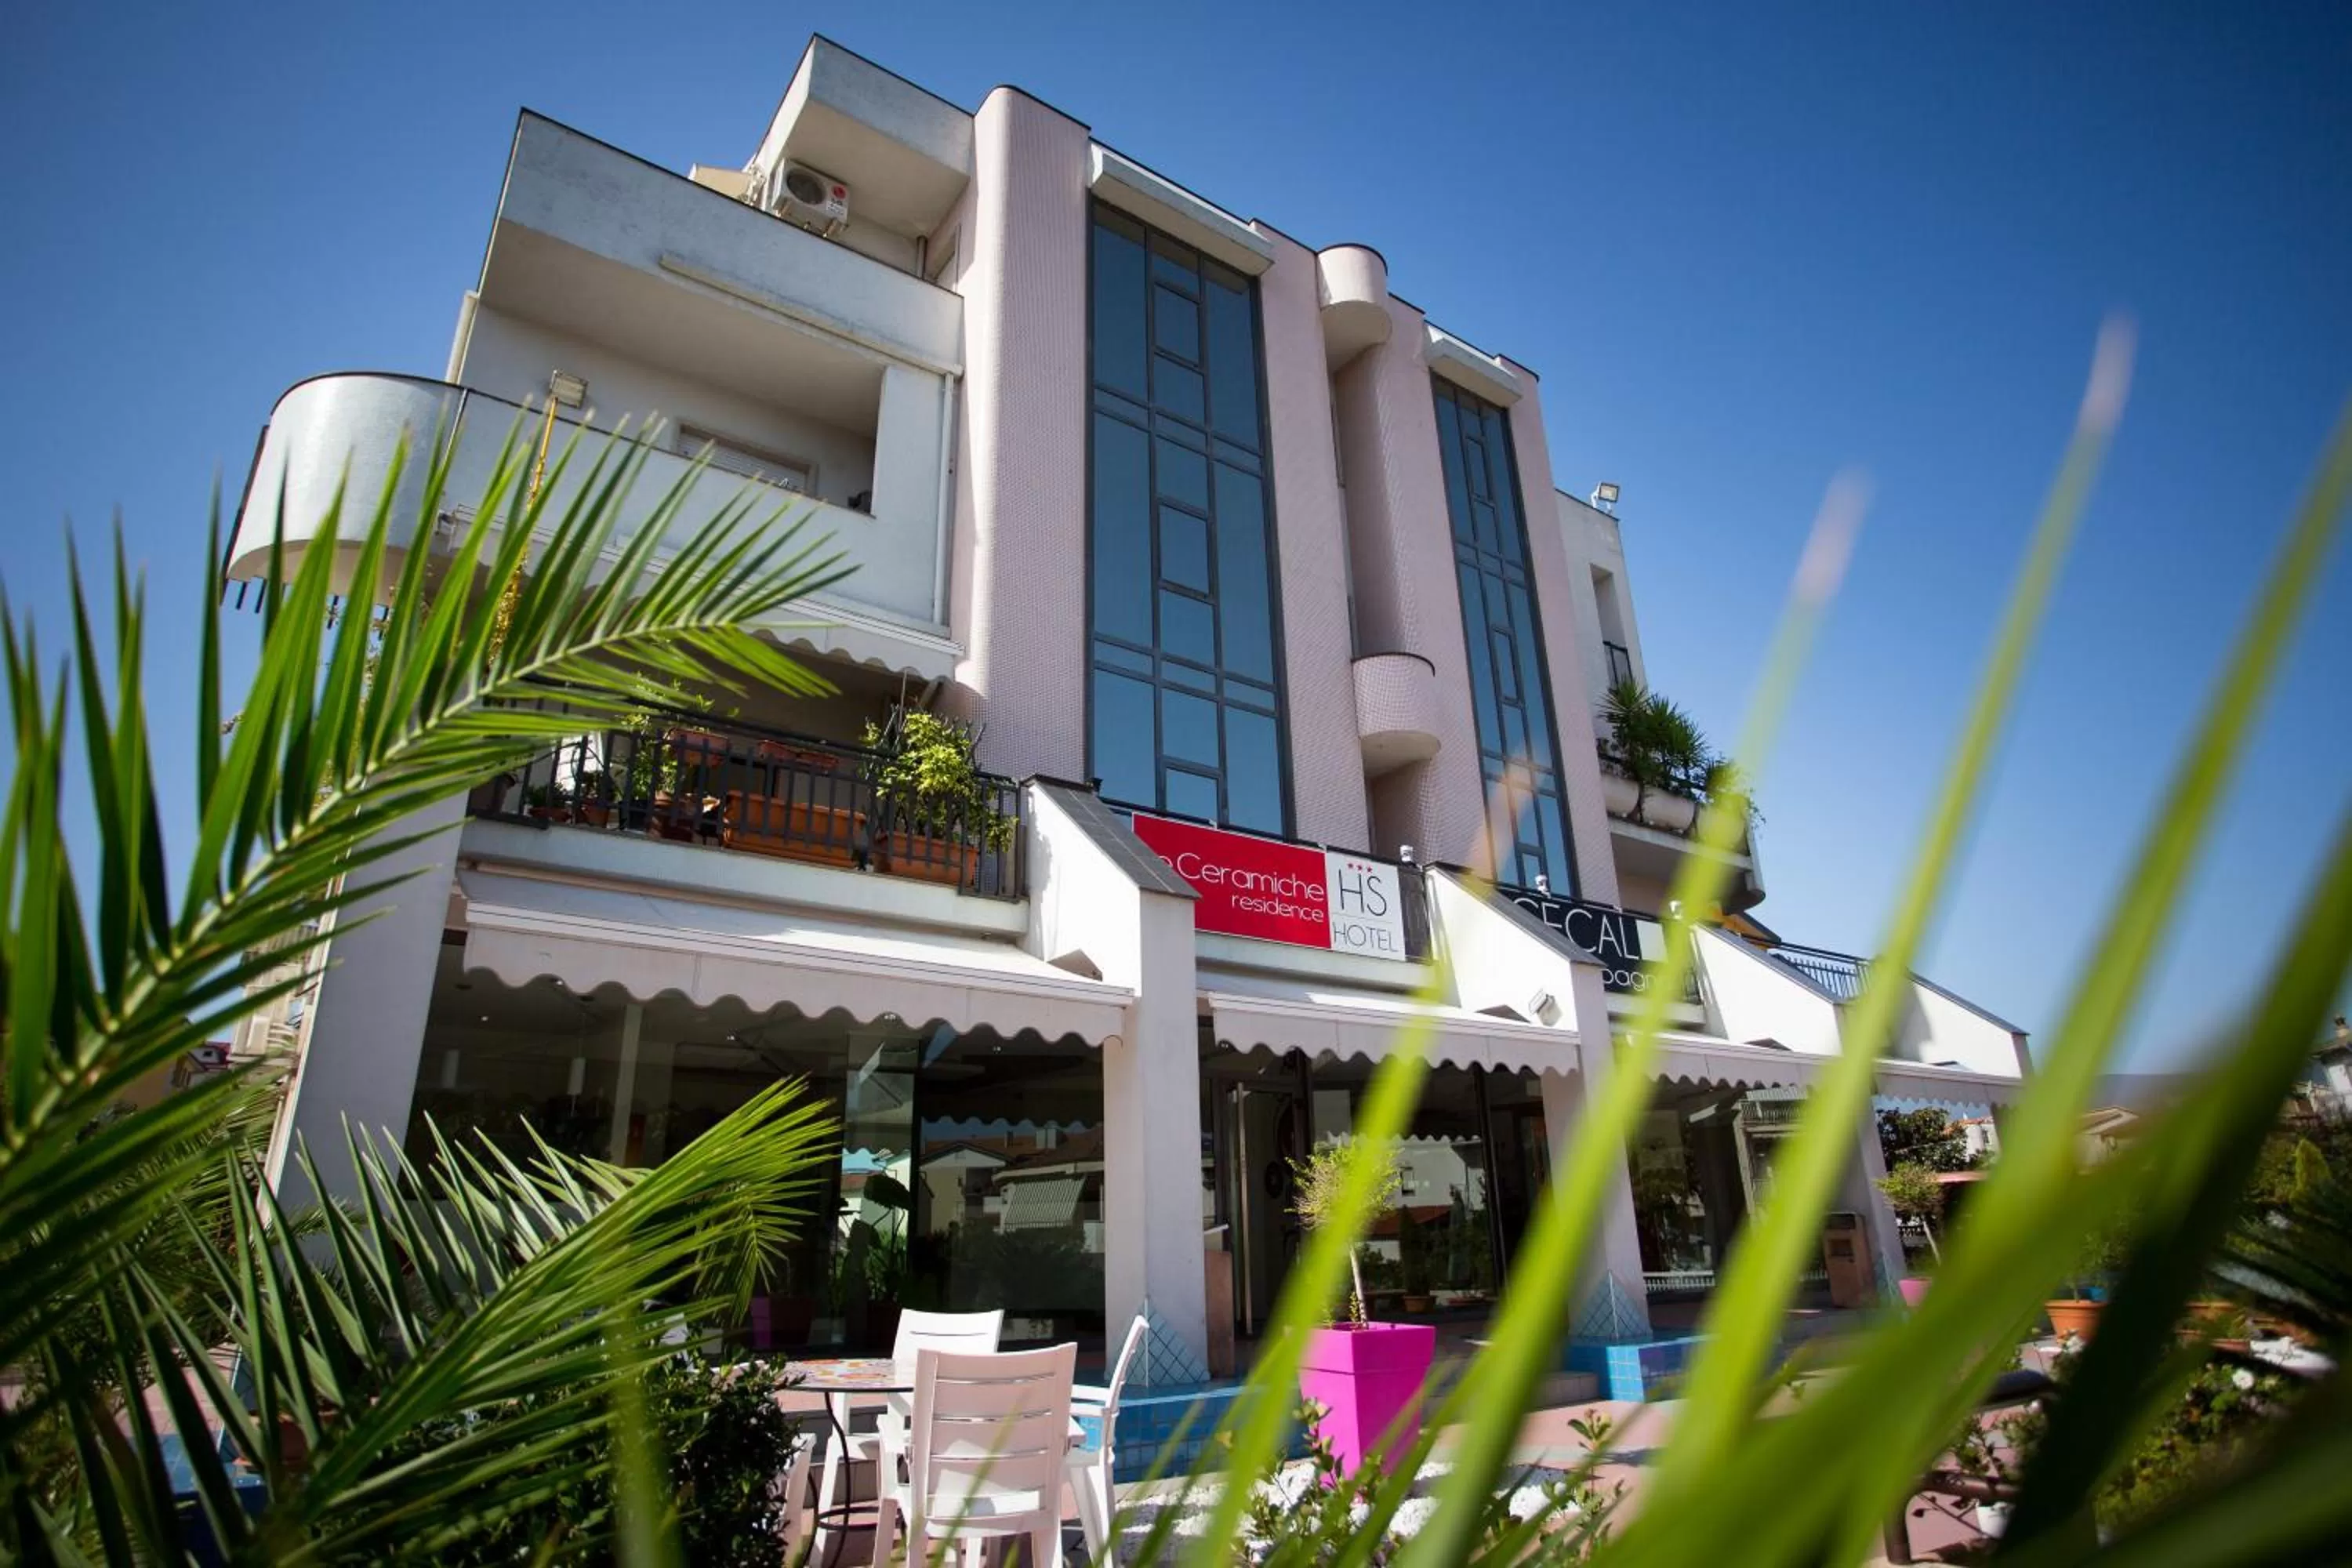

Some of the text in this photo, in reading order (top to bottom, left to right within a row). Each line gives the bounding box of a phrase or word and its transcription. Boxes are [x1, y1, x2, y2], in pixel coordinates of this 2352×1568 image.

[1177, 852, 1324, 902] Ceramiche
[1338, 869, 1387, 916] HS
[1231, 895, 1324, 923] residence
[1332, 922, 1399, 953] HOTEL
